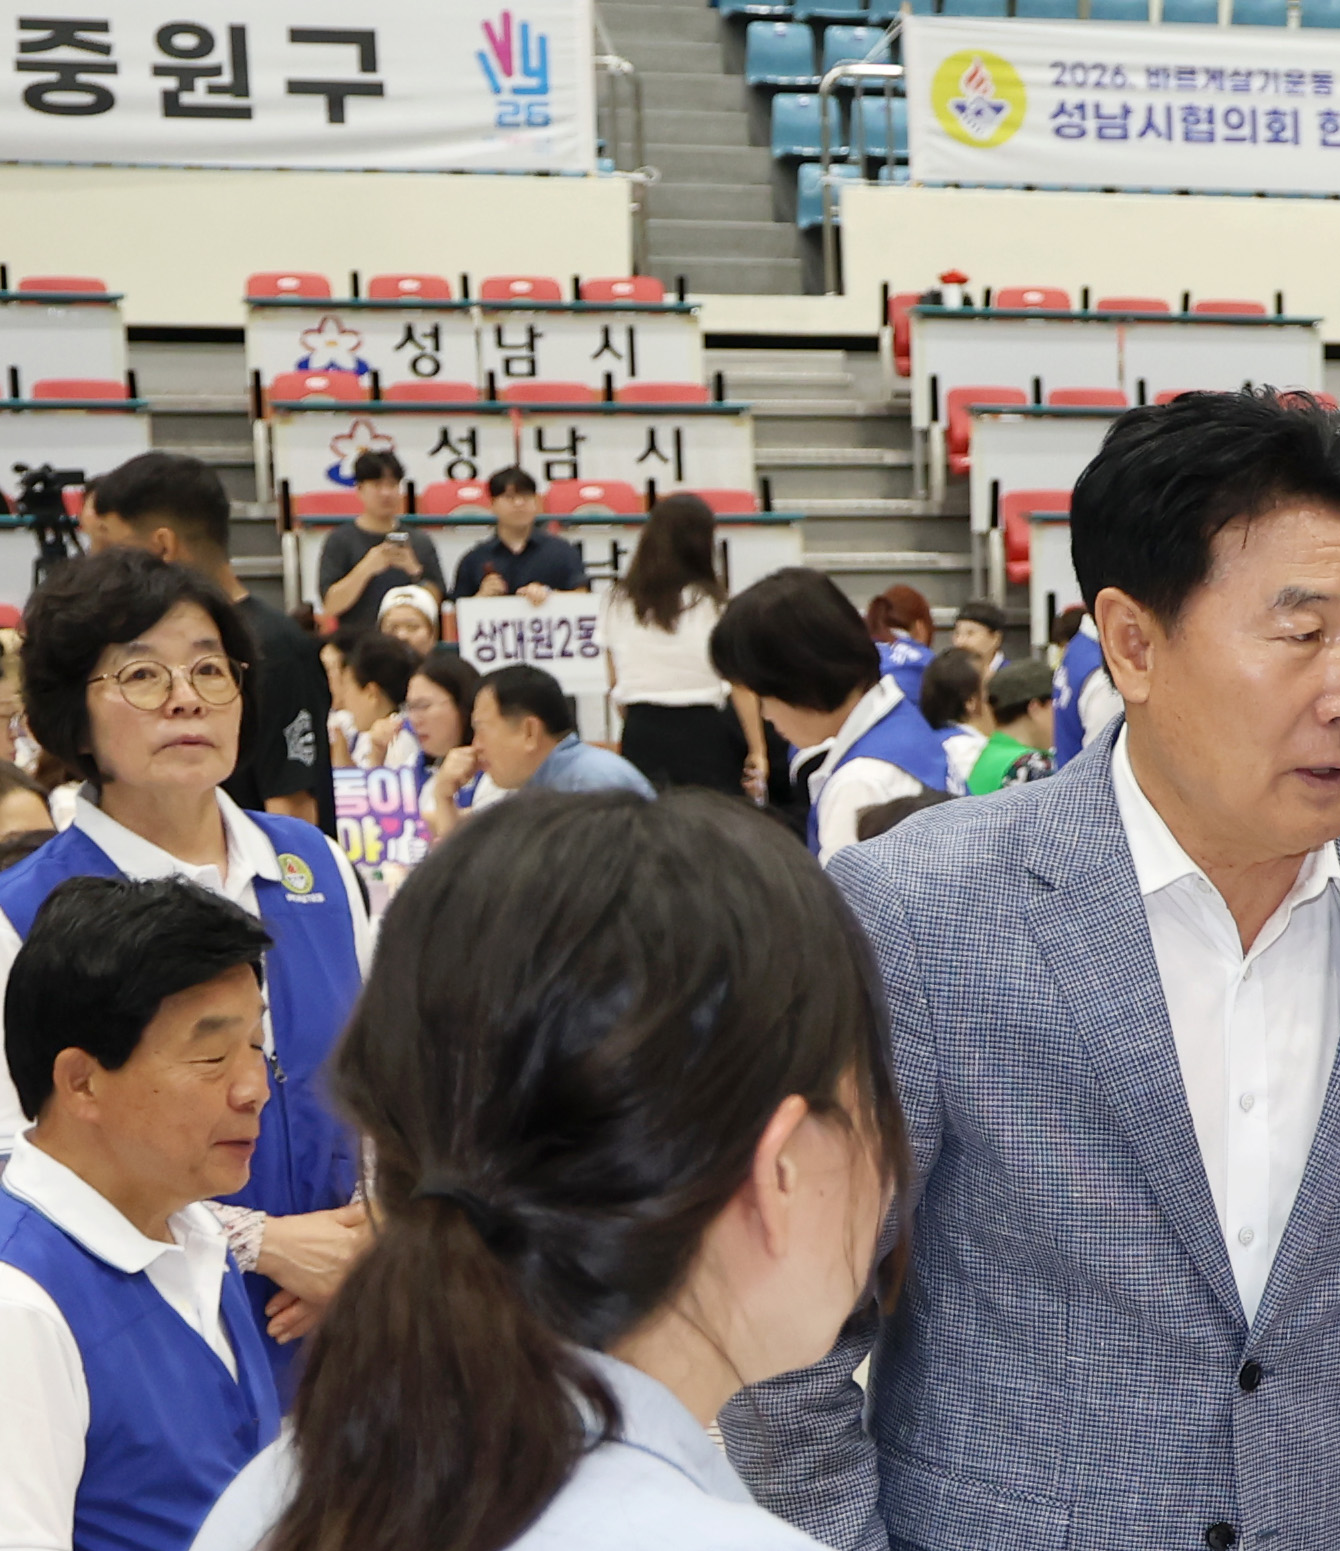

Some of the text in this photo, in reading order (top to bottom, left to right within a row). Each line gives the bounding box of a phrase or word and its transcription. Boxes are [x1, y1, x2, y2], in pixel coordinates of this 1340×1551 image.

[14, 16, 385, 125] 중원구
[1144, 64, 1334, 97] 바르게살기운동
[1049, 100, 1301, 146] 성남시협의회
[472, 616, 600, 662] 상대원2동
